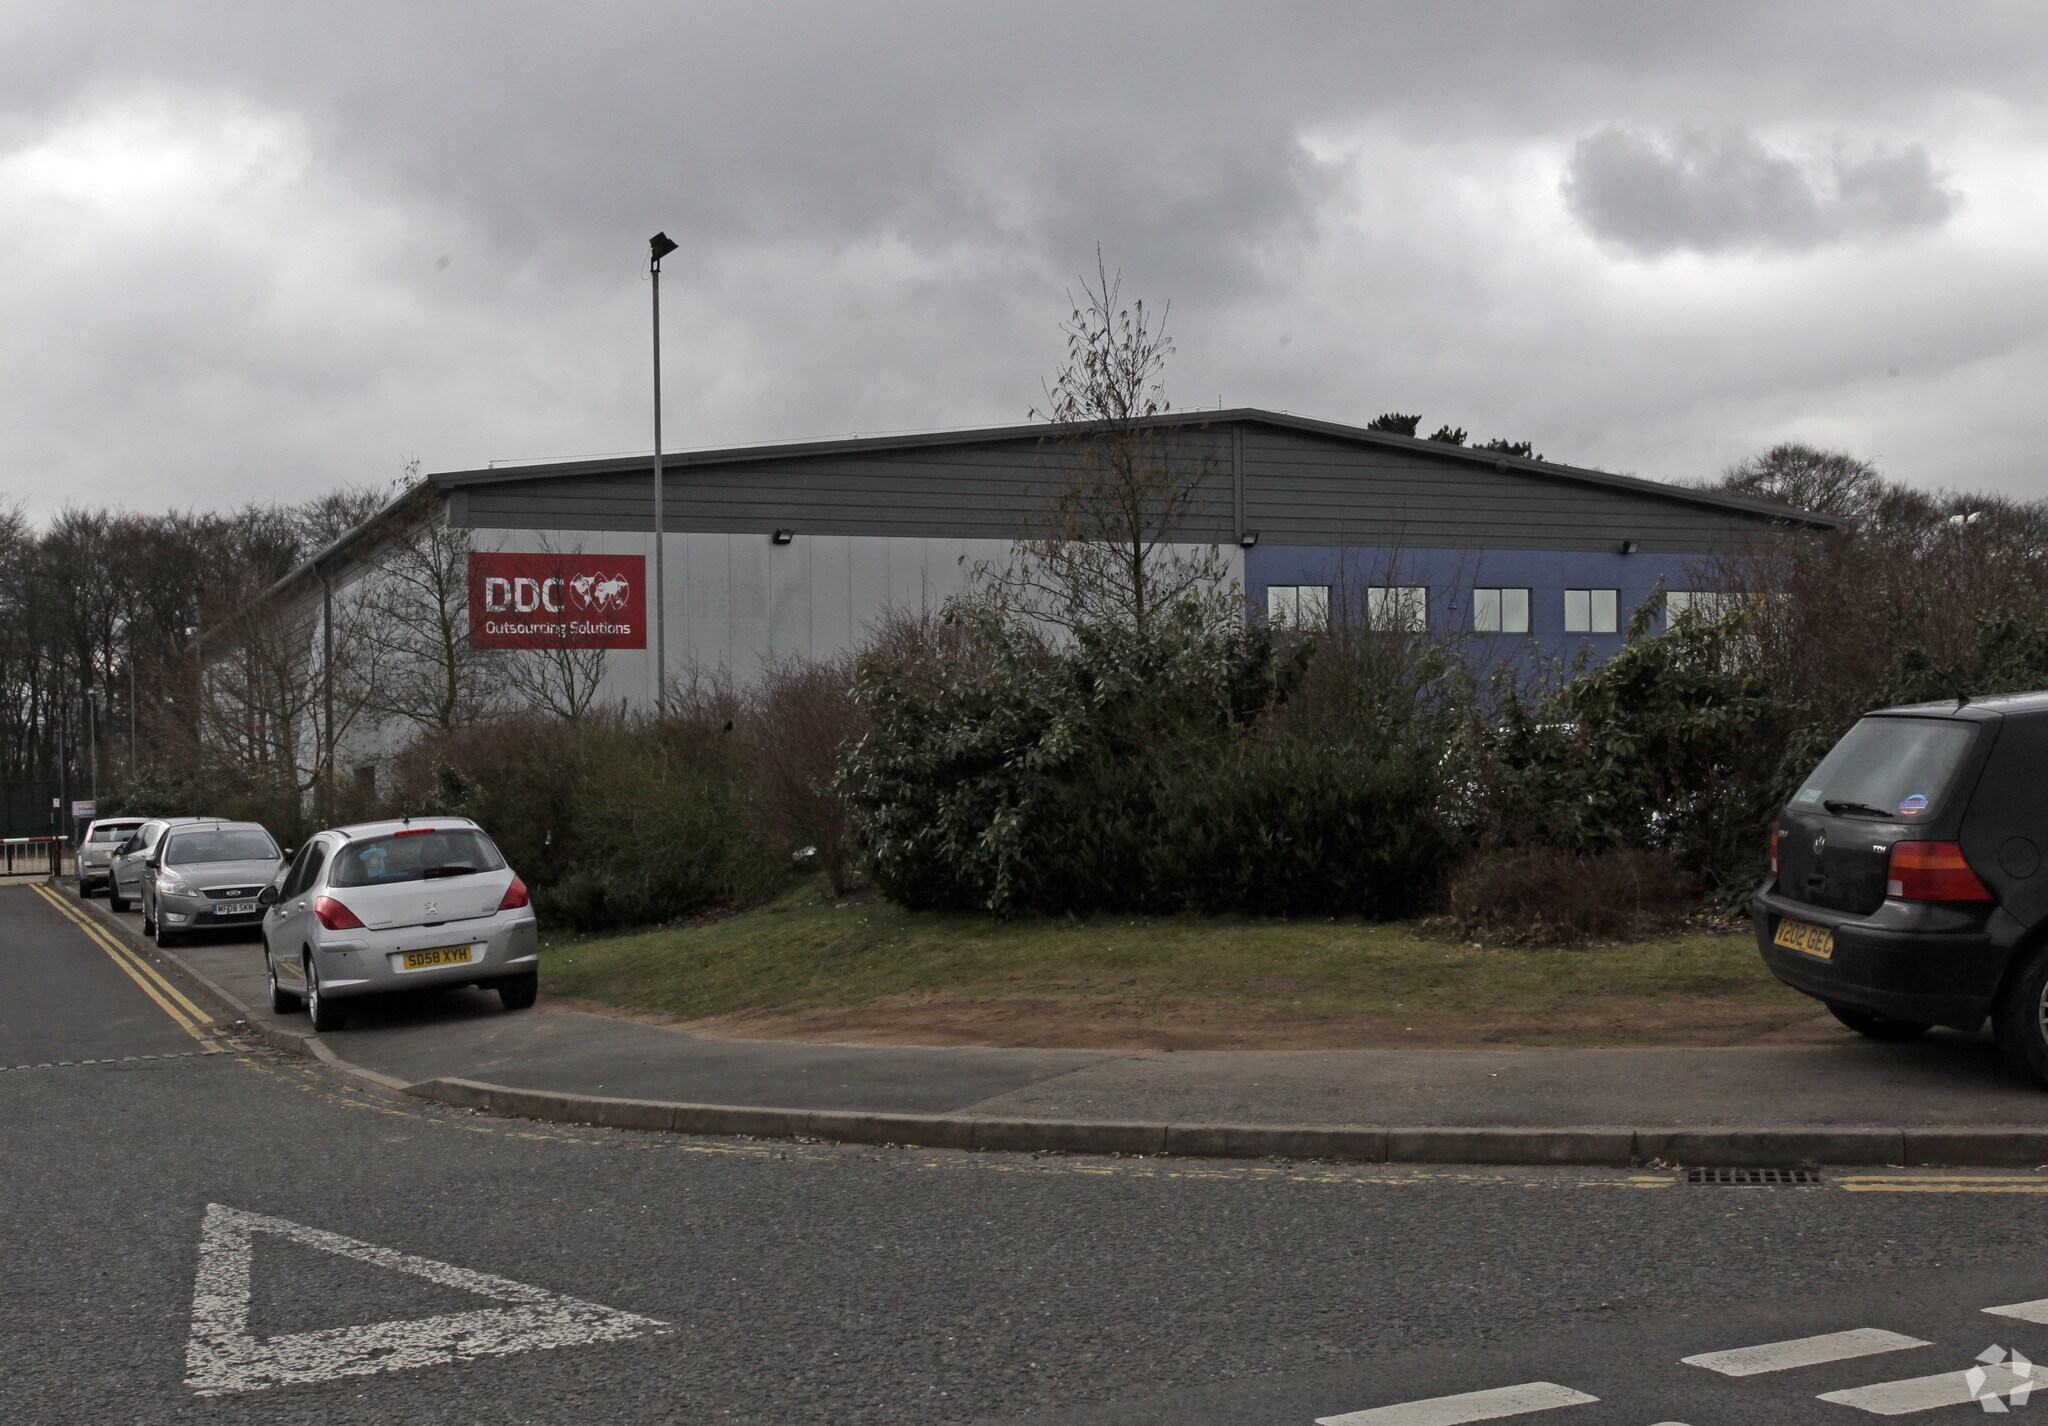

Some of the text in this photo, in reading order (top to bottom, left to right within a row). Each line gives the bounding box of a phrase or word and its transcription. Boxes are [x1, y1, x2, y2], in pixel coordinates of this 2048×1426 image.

[486, 578, 565, 612] DDC
[486, 621, 631, 638] Outsourcing Solutions
[239, 903, 254, 911] SKN
[408, 948, 467, 966] SD58 XYH
